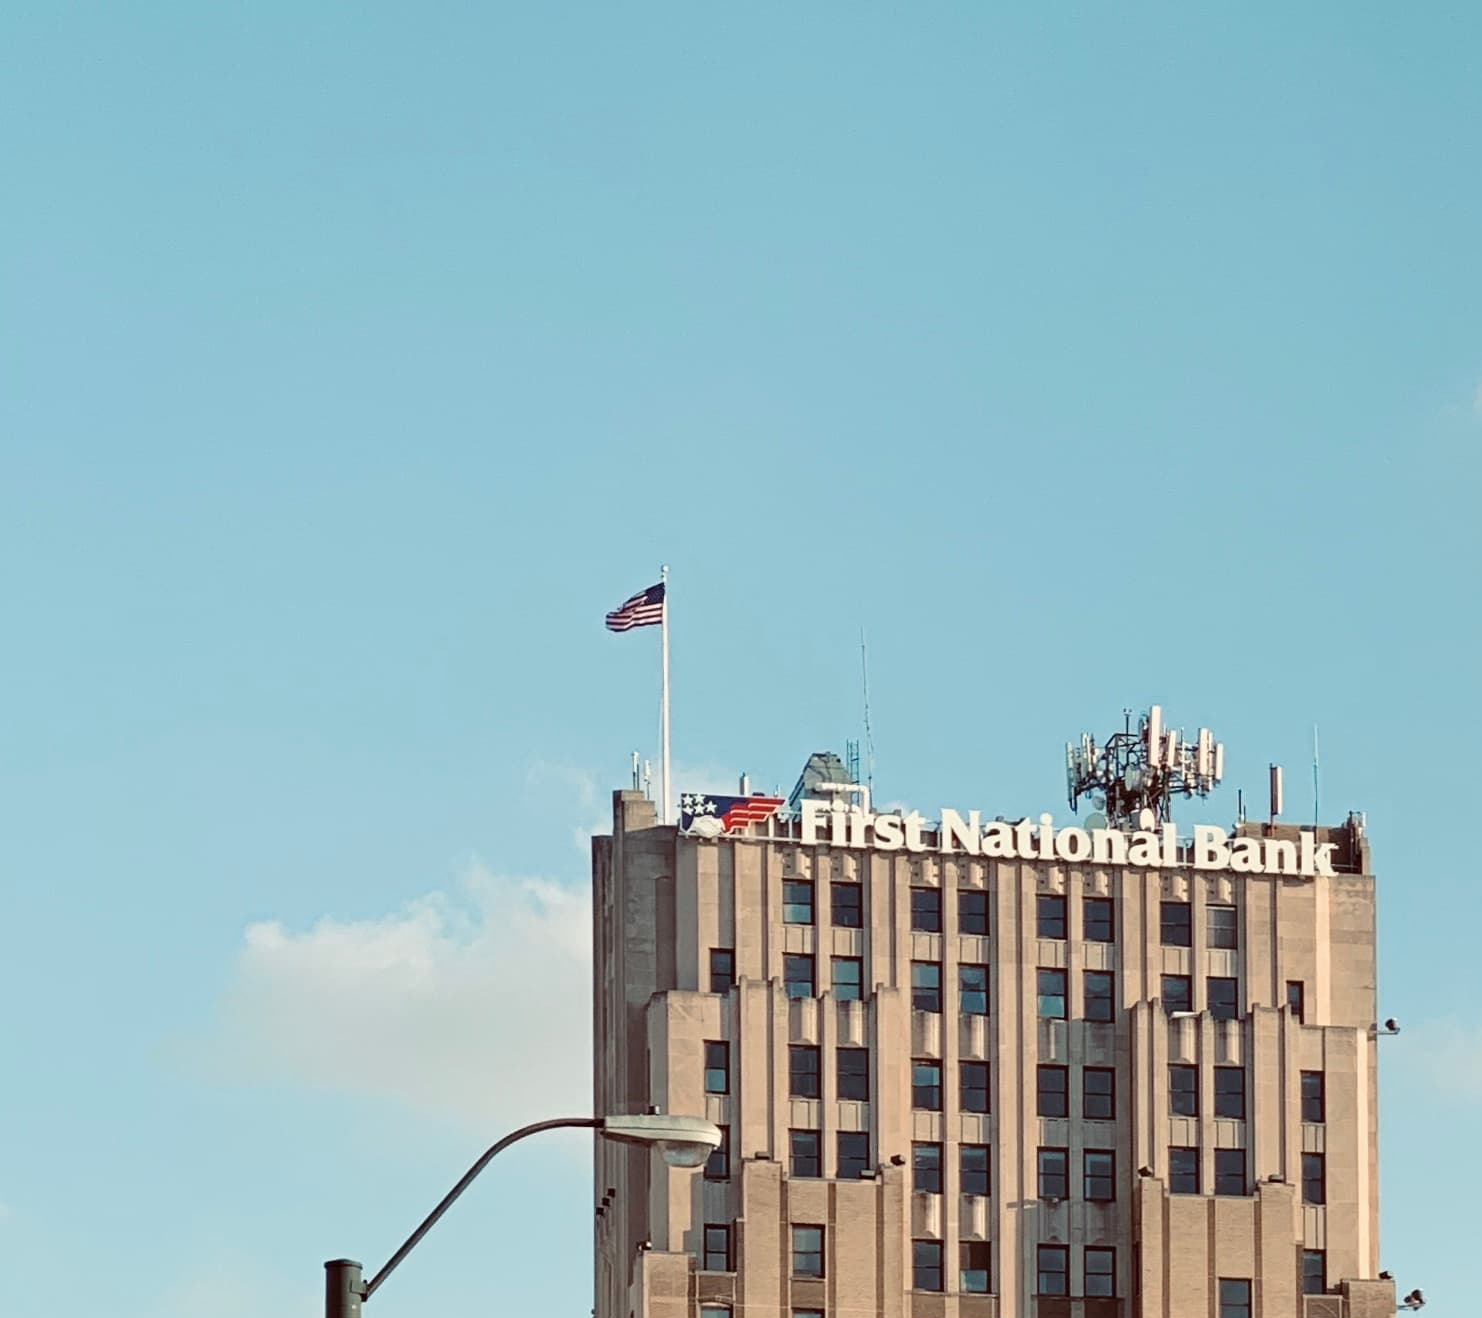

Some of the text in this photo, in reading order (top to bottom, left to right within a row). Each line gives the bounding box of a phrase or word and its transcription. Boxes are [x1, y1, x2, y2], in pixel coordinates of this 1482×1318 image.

[799, 797, 1338, 878] First National Bank
